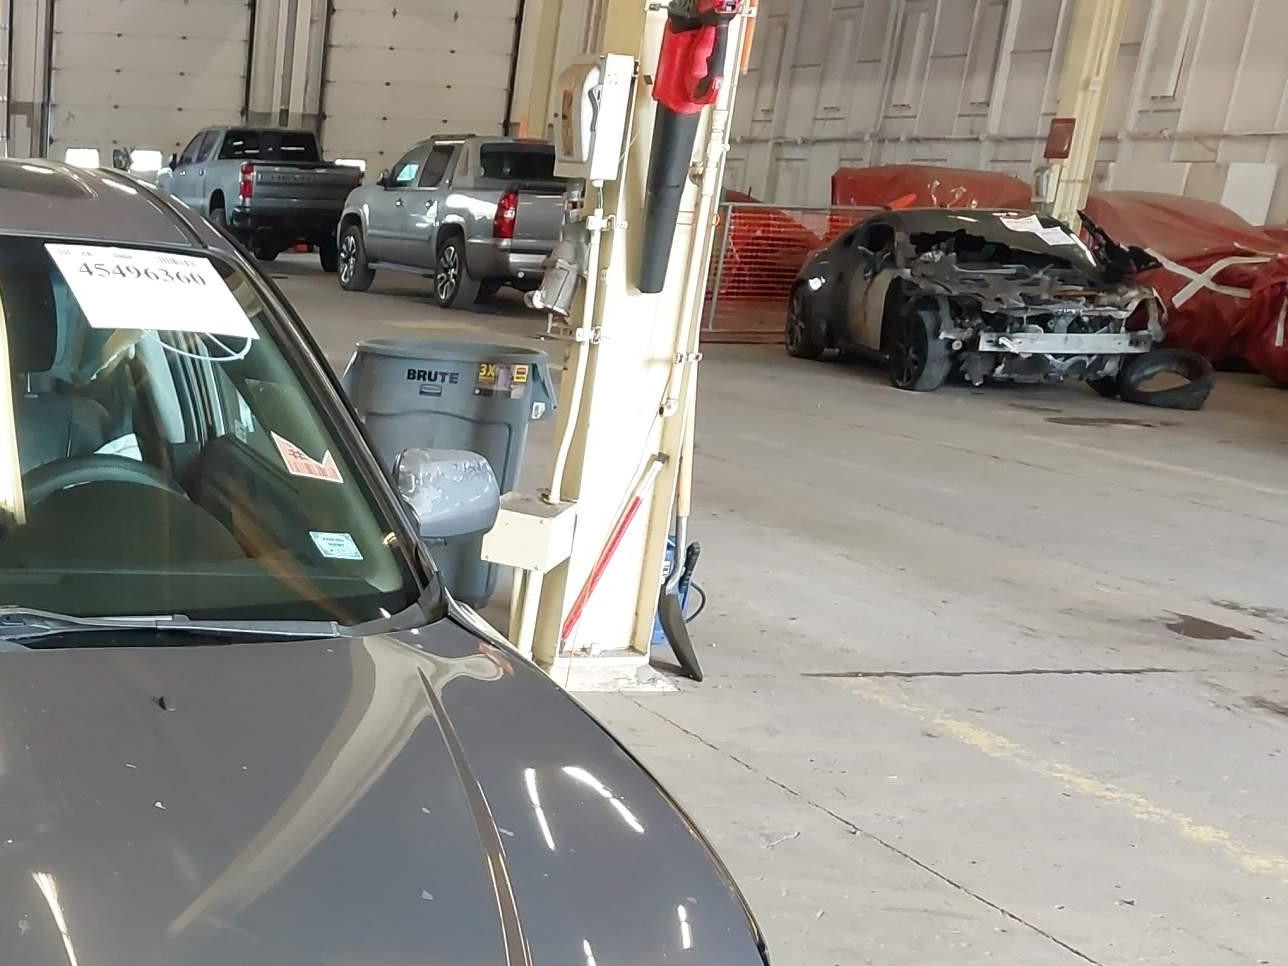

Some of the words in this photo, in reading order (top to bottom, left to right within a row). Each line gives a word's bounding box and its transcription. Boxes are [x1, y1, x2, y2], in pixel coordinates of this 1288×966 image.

[79, 262, 207, 286] 45496360
[406, 368, 460, 385] BRUTE
[478, 363, 496, 377] 3X
